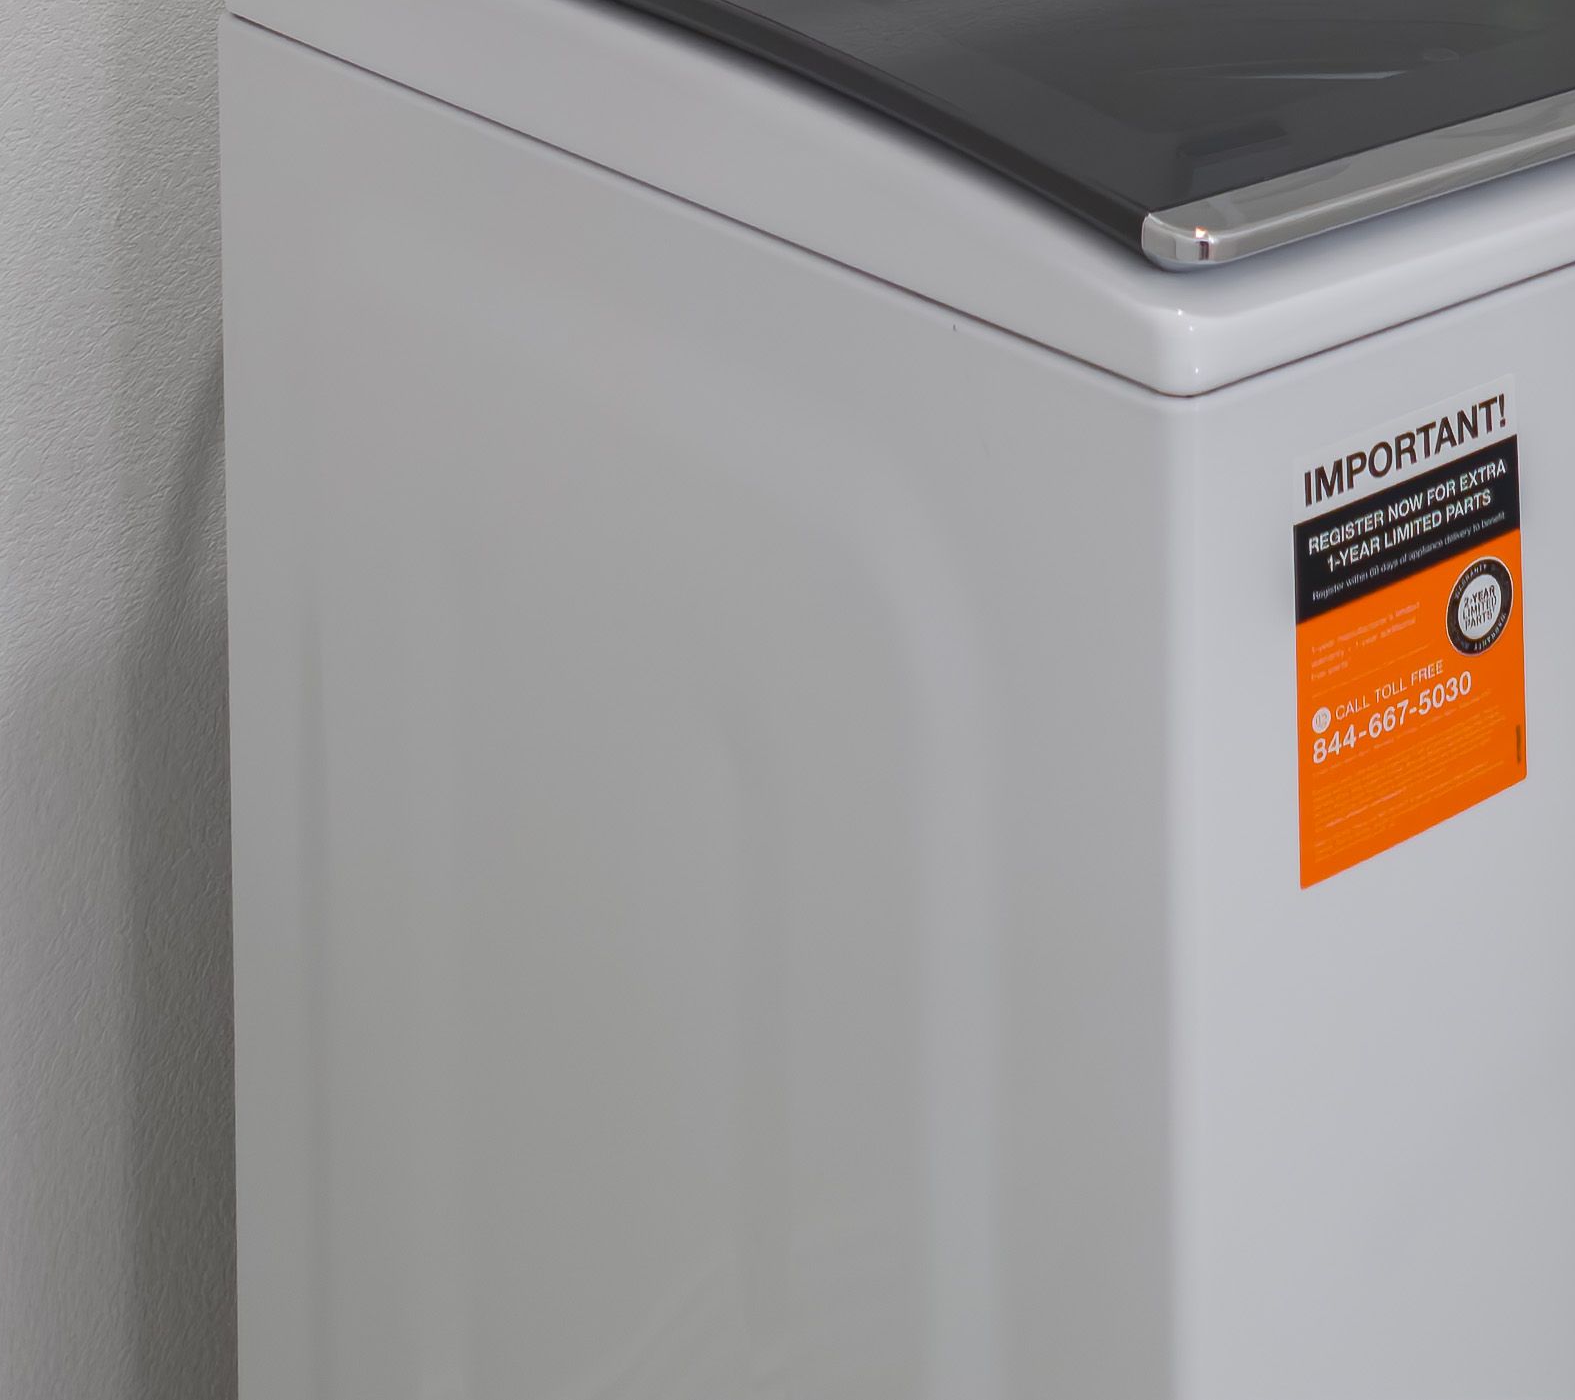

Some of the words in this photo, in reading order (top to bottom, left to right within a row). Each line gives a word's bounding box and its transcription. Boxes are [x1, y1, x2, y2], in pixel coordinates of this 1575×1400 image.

[1303, 393, 1507, 508] IMPORTANT!
[1308, 509, 1385, 556] REGISTER
[1387, 491, 1424, 523] NOW
[1426, 478, 1457, 507] FOR
[1460, 458, 1507, 493] EXTRA
[1326, 536, 1381, 573] 1-YEAR
[1384, 509, 1442, 549] LIMITED
[1445, 488, 1492, 522] PARTS
[1312, 581, 1345, 602] Register
[1345, 570, 1369, 588] within
[1380, 559, 1399, 574] days
[1408, 540, 1444, 562] appliance
[1464, 584, 1496, 608] 2-YEAR
[1312, 671, 1472, 765] 844-667-5030
[1335, 695, 1371, 721] CALL
[1374, 677, 1408, 703] TOLL
[1411, 659, 1444, 686] FREE
